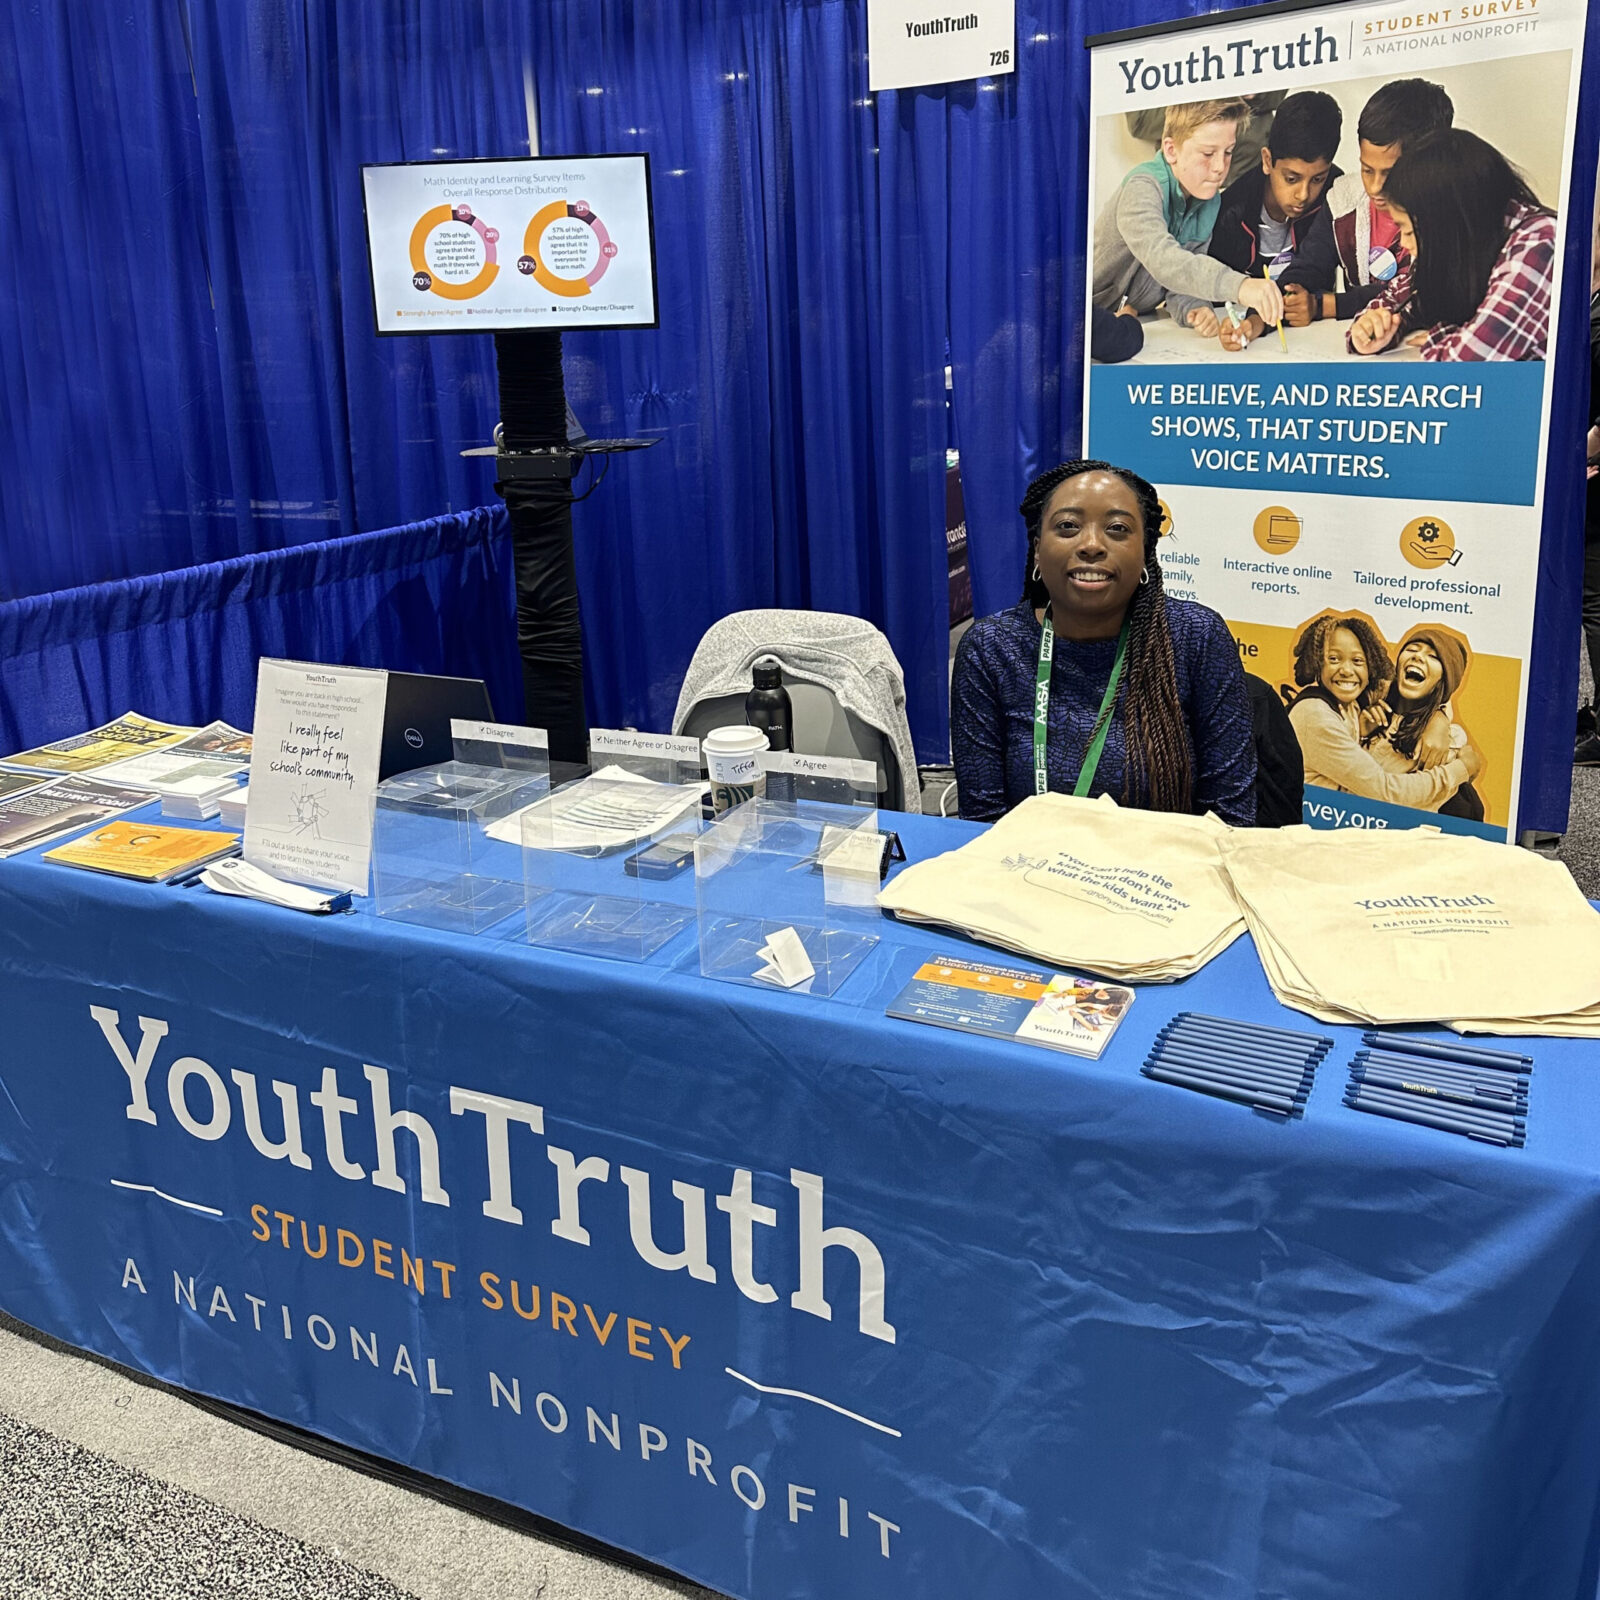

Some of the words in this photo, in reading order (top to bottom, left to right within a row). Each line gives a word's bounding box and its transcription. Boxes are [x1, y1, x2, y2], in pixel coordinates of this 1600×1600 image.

[906, 14, 978, 38] YouthTruth
[1364, 10, 1452, 34] STUDENT
[1460, 0, 1539, 18] SURVEY
[1363, 46, 1372, 56] A
[1376, 32, 1447, 54] NATIONAL
[1452, 20, 1539, 43] NONPROFIT
[990, 50, 1010, 66] 726
[1119, 26, 1338, 94] YouthTruth
[424, 177, 445, 186] Math
[447, 176, 478, 187] Identity
[480, 176, 494, 184] and
[496, 174, 531, 184] Learning
[533, 173, 560, 183] Survey
[562, 172, 586, 181] Items
[443, 188, 473, 197] Overall
[475, 188, 513, 198] Response
[514, 186, 568, 195] Distributions
[558, 305, 581, 313] Strongly
[582, 303, 634, 312] Disagree/Disagree
[1128, 384, 1164, 404] WE
[1171, 384, 1266, 408] BELIEVE,
[1270, 385, 1329, 407] AND
[1335, 385, 1482, 409] RESEARCH
[1150, 416, 1241, 440] SHOWS,
[1246, 418, 1314, 440] THAT
[1318, 420, 1448, 445] STUDENT
[1190, 448, 1259, 471] VOICE
[1267, 452, 1390, 479] MATTERS.
[1160, 552, 1200, 566] reliable
[1224, 558, 1289, 575] Interactive
[1293, 566, 1332, 579] online
[1162, 570, 1195, 584] amily,
[1251, 580, 1300, 595] reports.
[1353, 571, 1407, 588] Tailored
[1410, 578, 1501, 597] professional
[1374, 593, 1473, 614] development.
[1043, 631, 1051, 658] PAPER
[306, 674, 337, 683] YouthTruth
[107, 725, 166, 738] SCHOOL
[289, 722, 293, 734] I
[296, 724, 320, 744] really
[323, 726, 344, 743] feel
[486, 727, 514, 738] Disagree
[281, 740, 298, 754] like
[301, 745, 321, 761] part
[323, 746, 334, 764] of
[336, 752, 348, 768] my
[603, 736, 631, 746] Neither
[632, 739, 654, 750] Agree
[665, 741, 698, 754] Disagree
[270, 760, 302, 775] school's
[306, 768, 355, 790] community.
[802, 760, 827, 770] Agree
[1048, 866, 1078, 879] what
[1080, 876, 1101, 885] the
[1102, 882, 1129, 899] kids
[1122, 868, 1149, 878] help
[1151, 874, 1173, 890] the
[1118, 876, 1152, 895] don't
[1153, 891, 1190, 909] know
[1354, 894, 1495, 910] YouthTruth
[1140, 909, 1174, 923] student
[1383, 918, 1442, 928] NATIONAL
[935, 960, 972, 971] STUDENT
[1034, 1024, 1093, 1041] YouthTruth
[1402, 1082, 1438, 1094] YouthTruth
[89, 1004, 897, 1344] YouthTruth
[251, 1203, 458, 1300] STUDENT
[480, 1272, 692, 1370] SURVEY
[120, 1257, 148, 1297] A
[172, 1268, 453, 1397] NATIONAL
[490, 1370, 902, 1558] NONPROFIT
